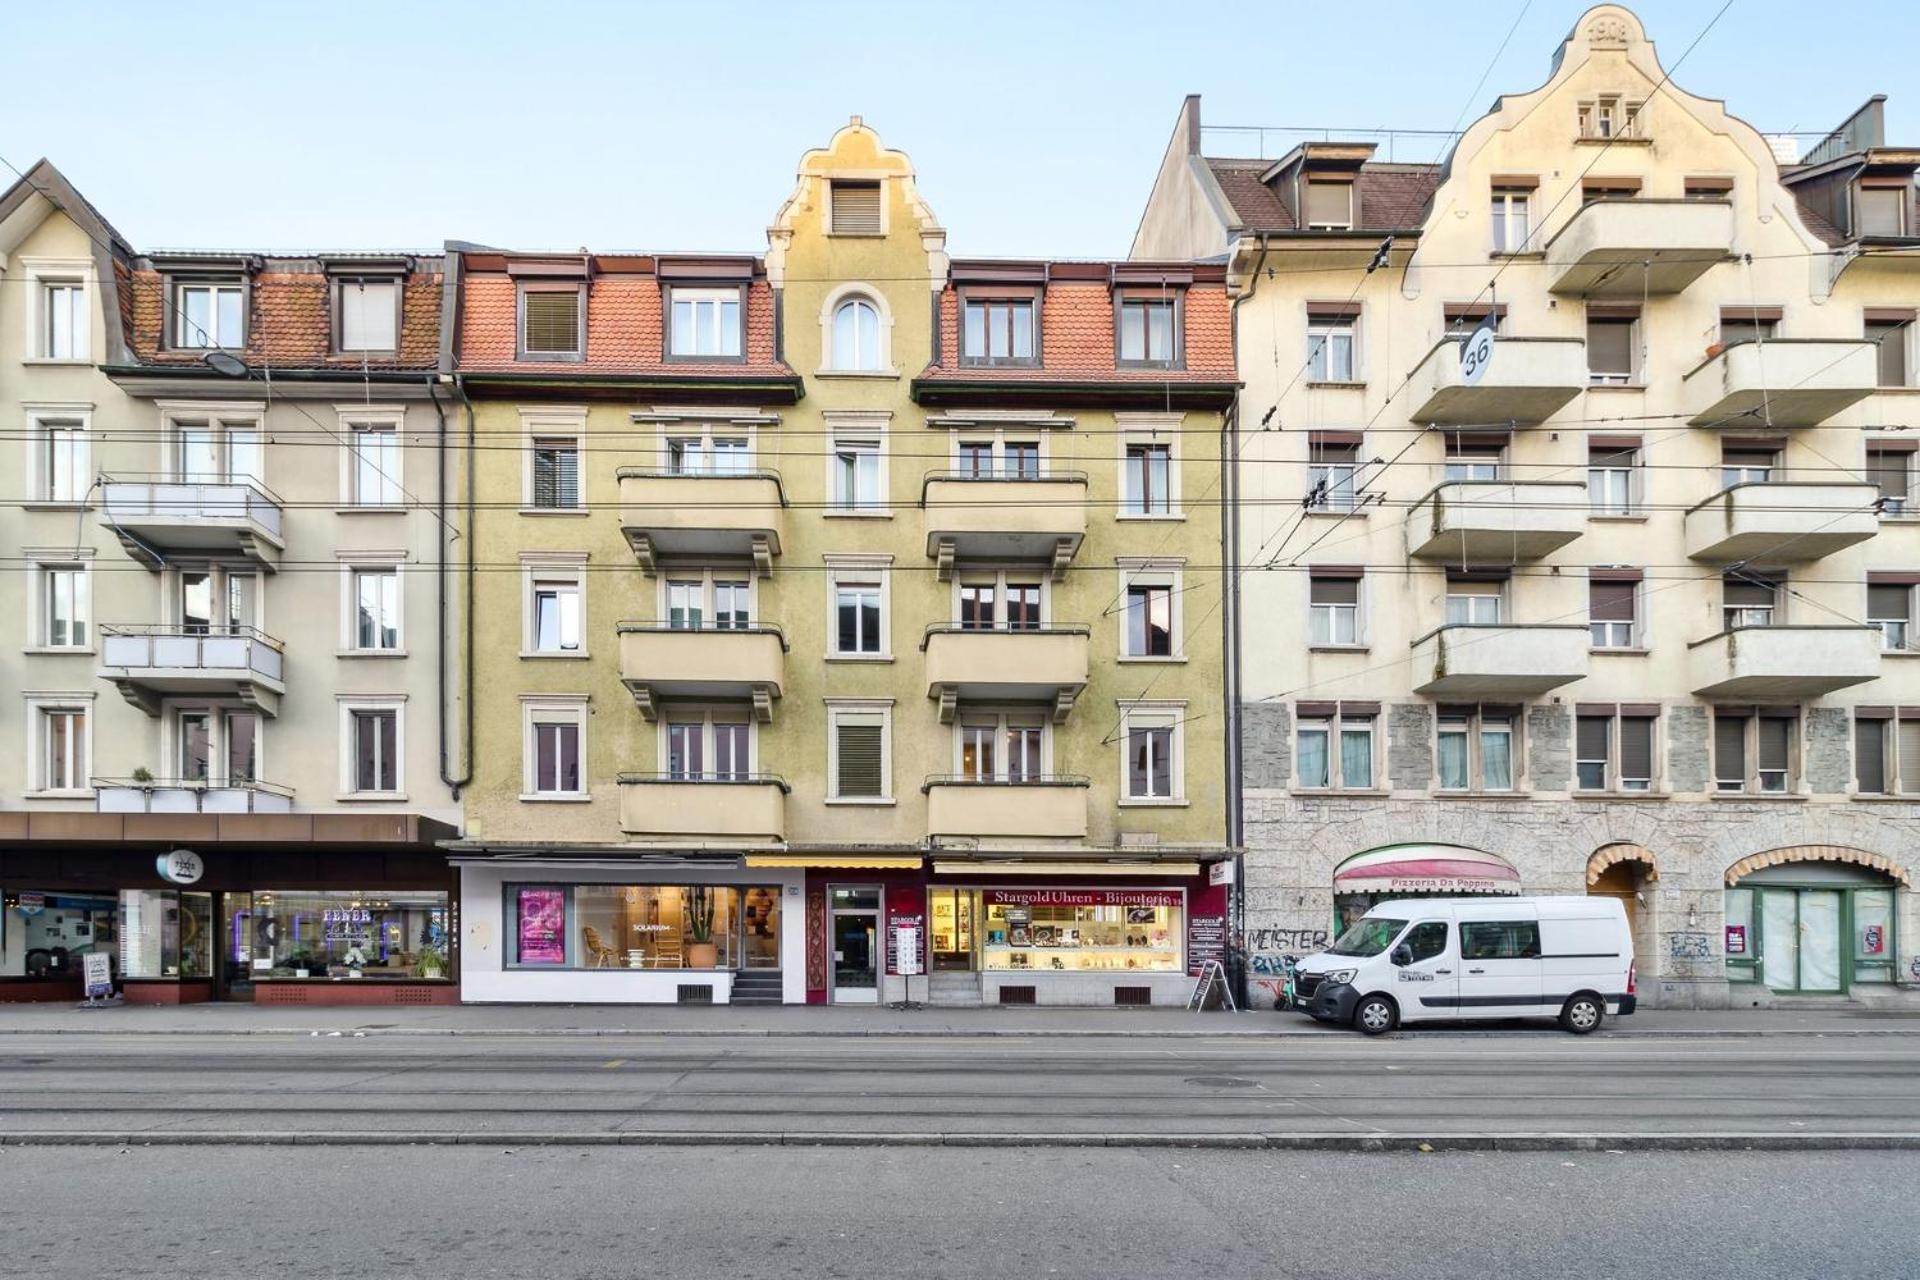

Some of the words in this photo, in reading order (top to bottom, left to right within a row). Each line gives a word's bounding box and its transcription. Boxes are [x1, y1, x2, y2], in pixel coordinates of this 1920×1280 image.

[1465, 338, 1489, 377] 36
[1391, 879, 1437, 887] Pizzeria
[1440, 879, 1455, 887] Da
[995, 890, 1050, 906] Stargold
[1052, 890, 1092, 904] Uhren
[1105, 891, 1171, 906] Bijouterie
